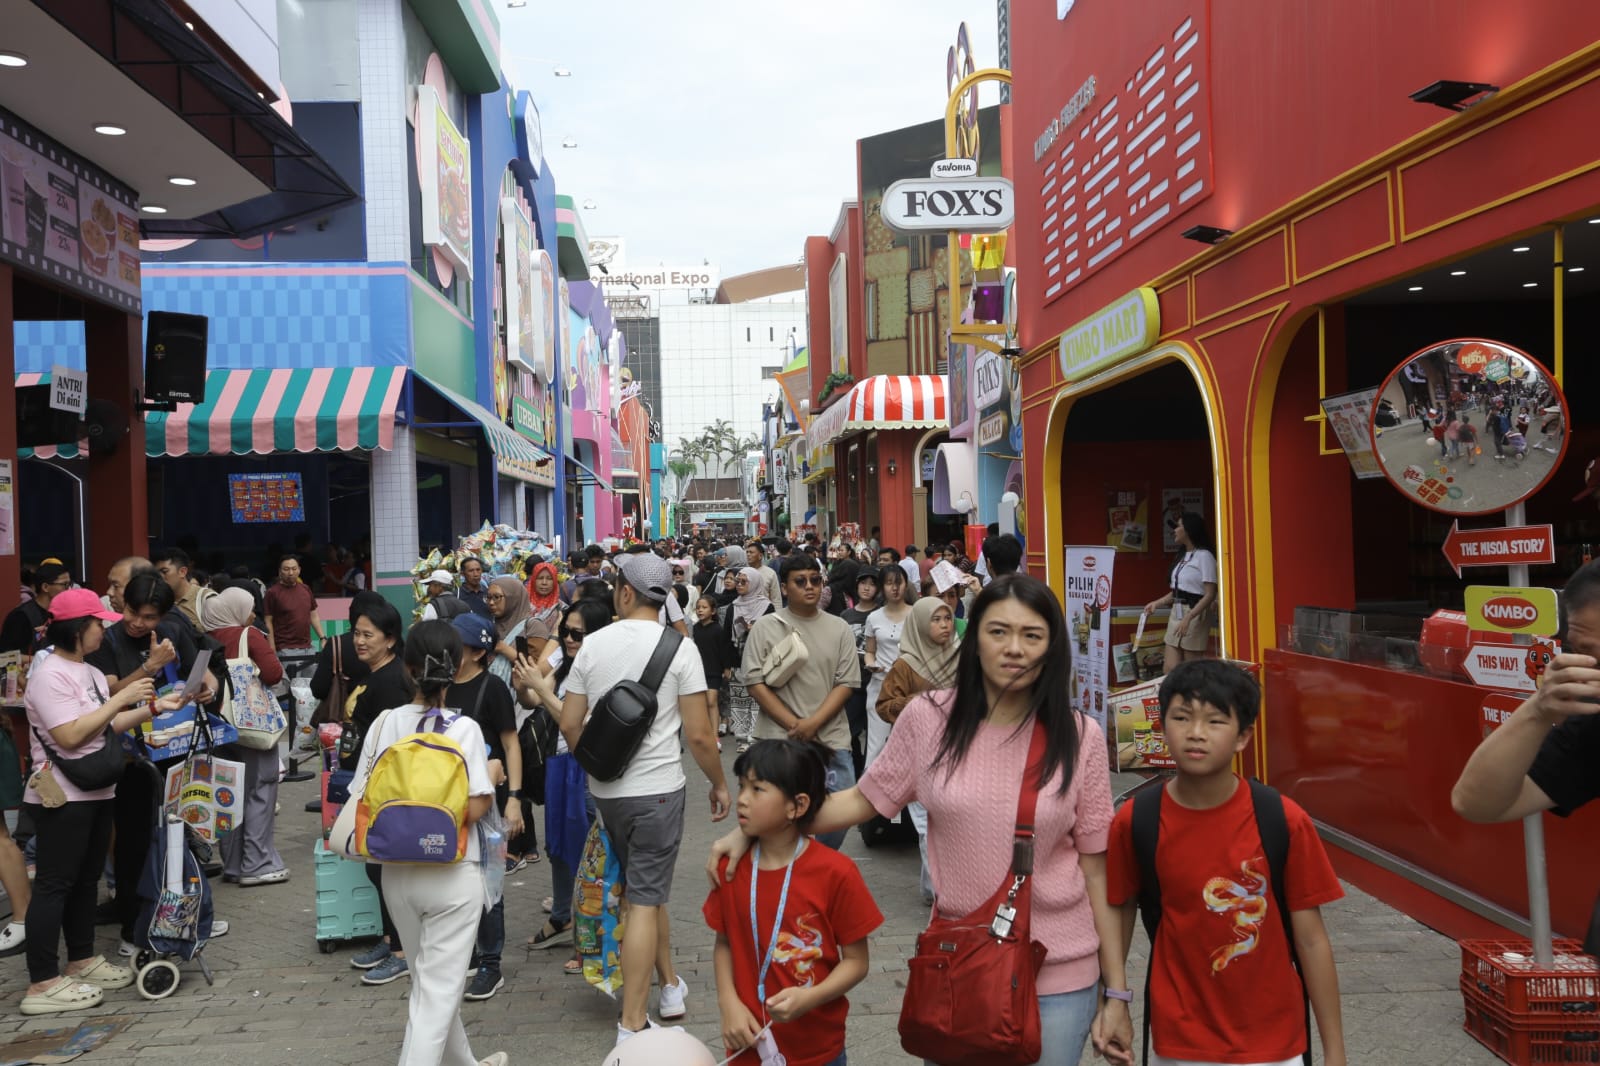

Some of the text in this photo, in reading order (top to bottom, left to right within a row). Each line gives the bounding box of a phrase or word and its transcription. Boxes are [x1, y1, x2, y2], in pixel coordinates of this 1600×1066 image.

[937, 162, 972, 172] SAVORIA
[902, 189, 1003, 217] FOX'S
[671, 272, 710, 287] Expo
[1064, 303, 1138, 371] KIMBO MART
[57, 376, 82, 393] ANTRI
[57, 391, 81, 408] Di sini
[517, 403, 542, 434] URBAN
[1460, 542, 1479, 556] THE
[1511, 538, 1545, 554] STORY
[1068, 576, 1093, 591] PILIH
[1483, 604, 1537, 621] KIMBO
[1476, 654, 1519, 671] THIS WAY!
[1482, 706, 1500, 723] THE
